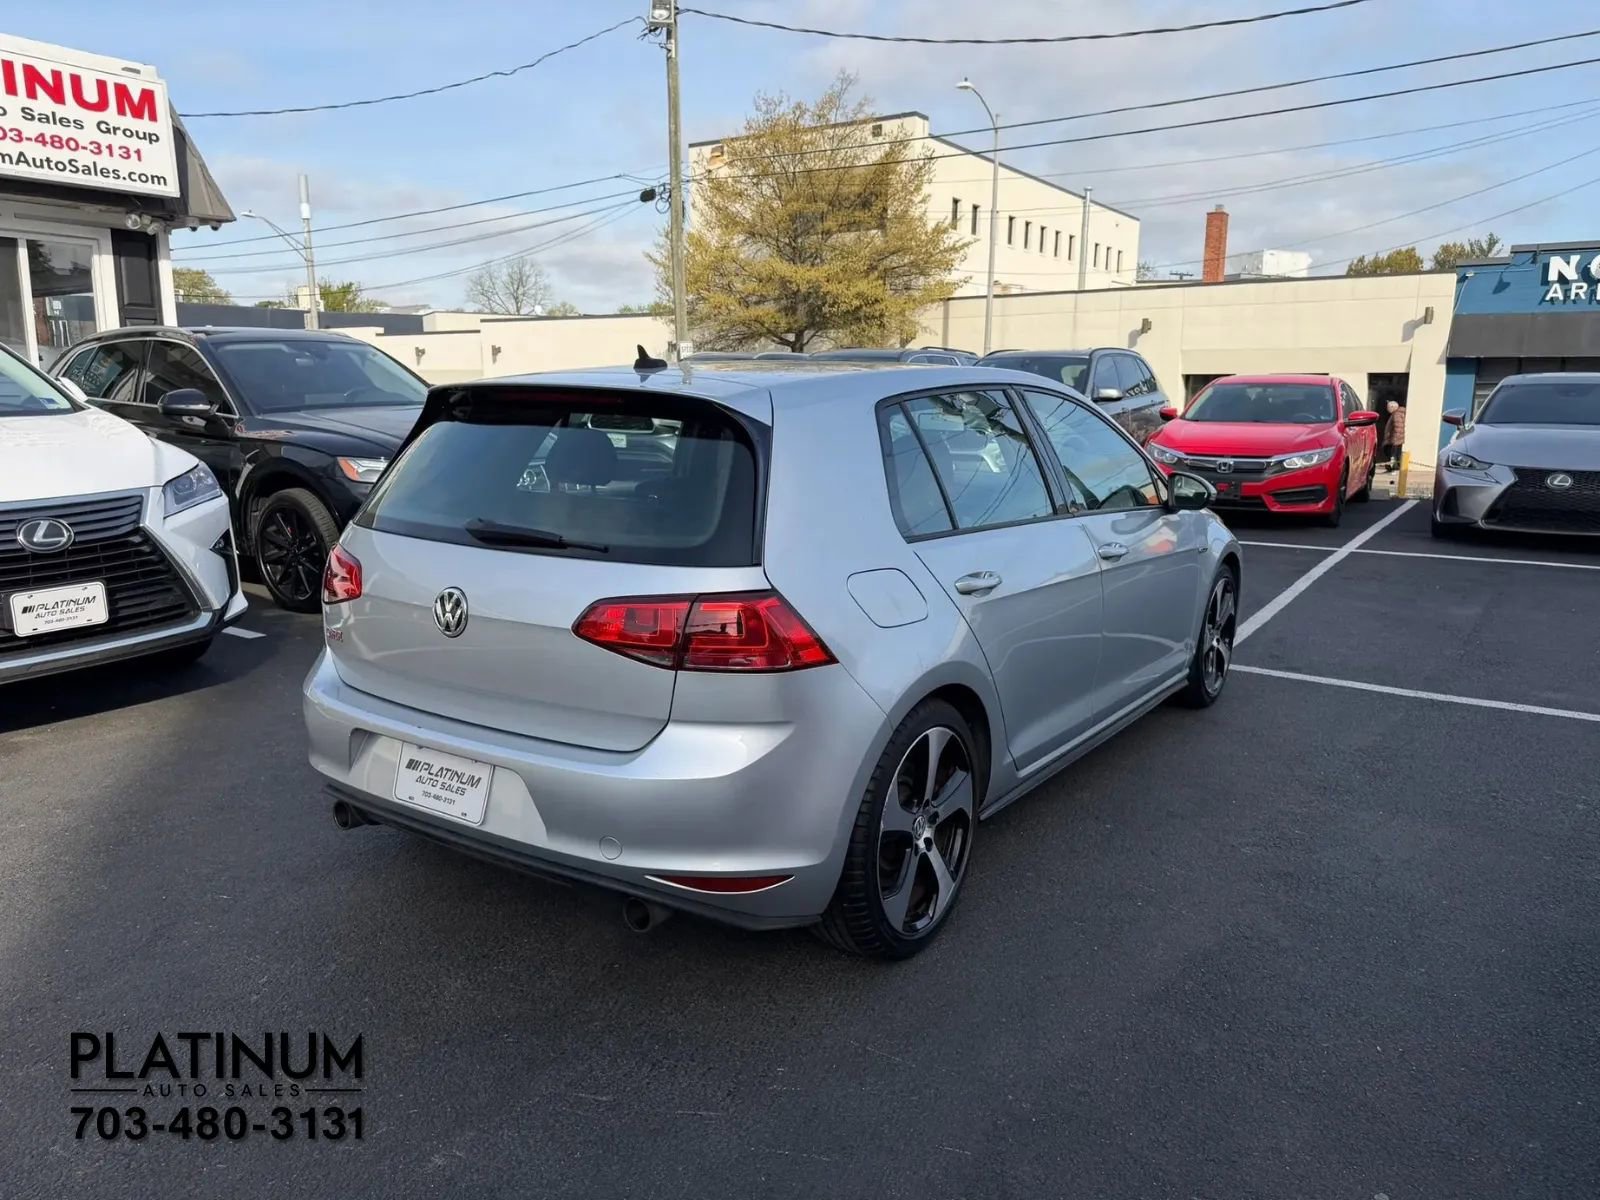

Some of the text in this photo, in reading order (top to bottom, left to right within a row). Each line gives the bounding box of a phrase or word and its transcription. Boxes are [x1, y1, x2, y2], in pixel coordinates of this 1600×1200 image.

[1, 58, 158, 123] INUM
[20, 106, 85, 130] Sales
[96, 120, 160, 145] Group
[0, 151, 168, 187] mAutoSales.com
[1545, 282, 1600, 301] AR
[34, 605, 86, 619] AUTO SALES
[36, 595, 96, 612] PLATINUM
[415, 775, 467, 796] AUTO SALES
[419, 761, 482, 789] PLATINUM
